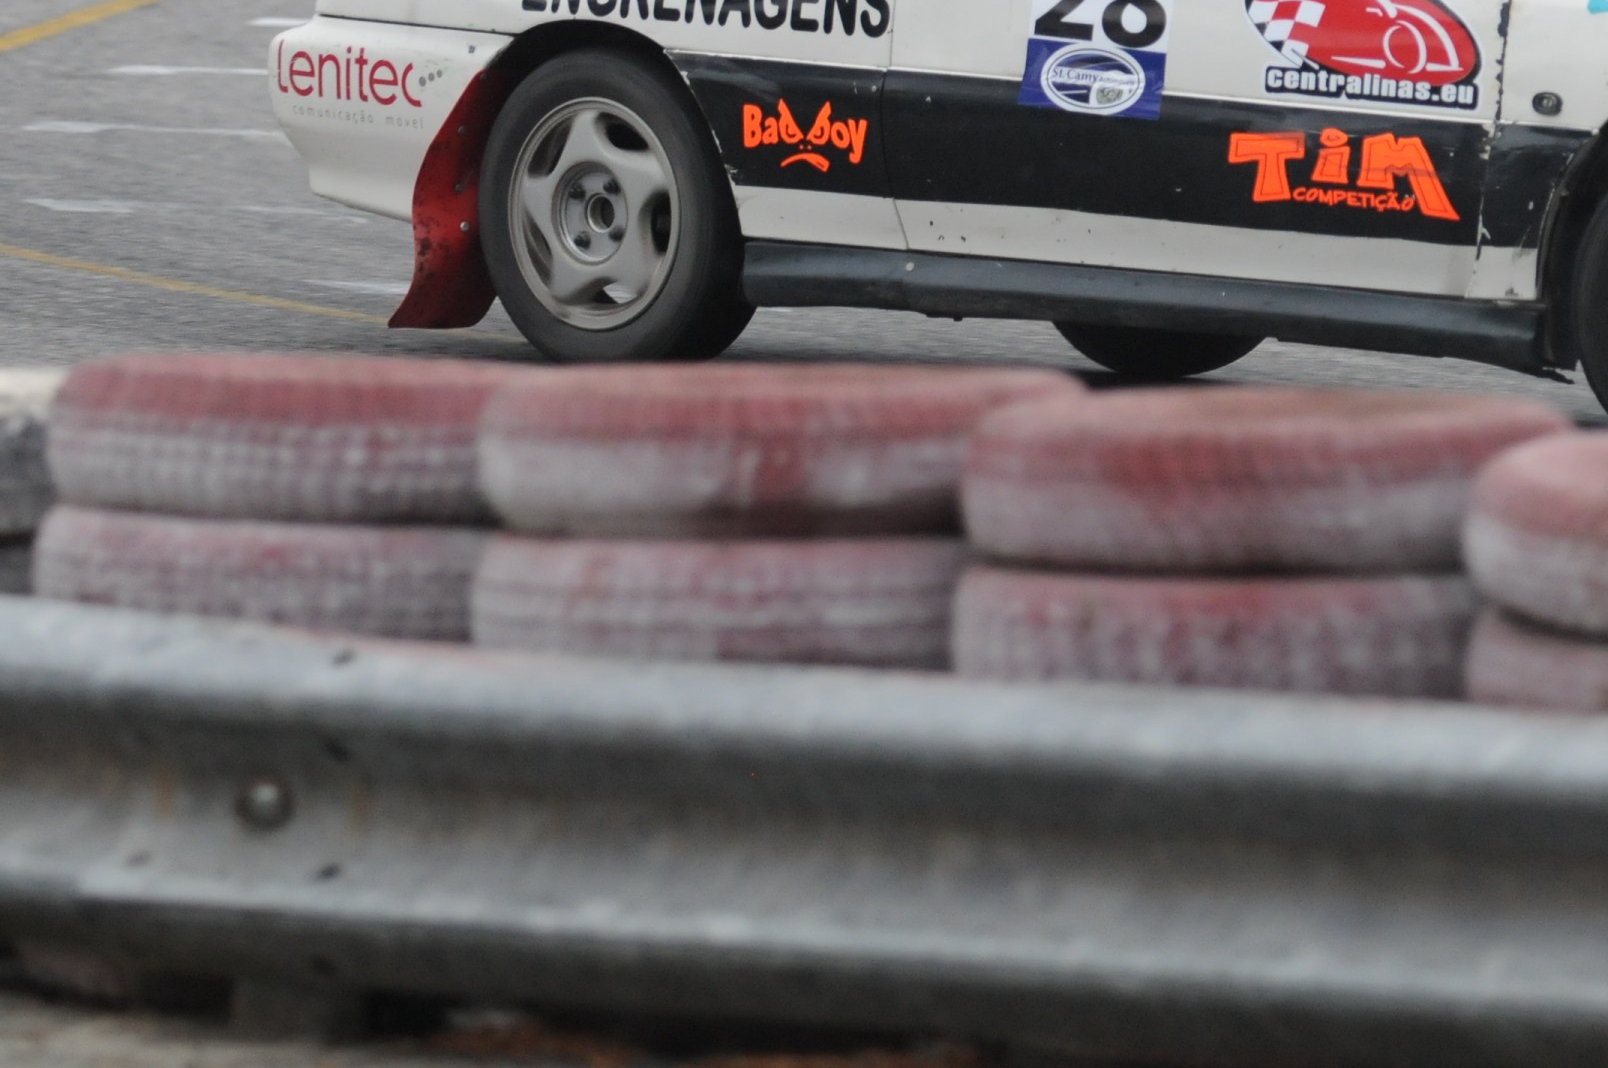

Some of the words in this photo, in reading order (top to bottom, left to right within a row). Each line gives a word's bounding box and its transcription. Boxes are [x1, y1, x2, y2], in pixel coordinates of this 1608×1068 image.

[1266, 68, 1475, 105] centralinas.eu
[292, 104, 374, 124] comunicação
[1292, 186, 1415, 212] COMPETIÇÃO
